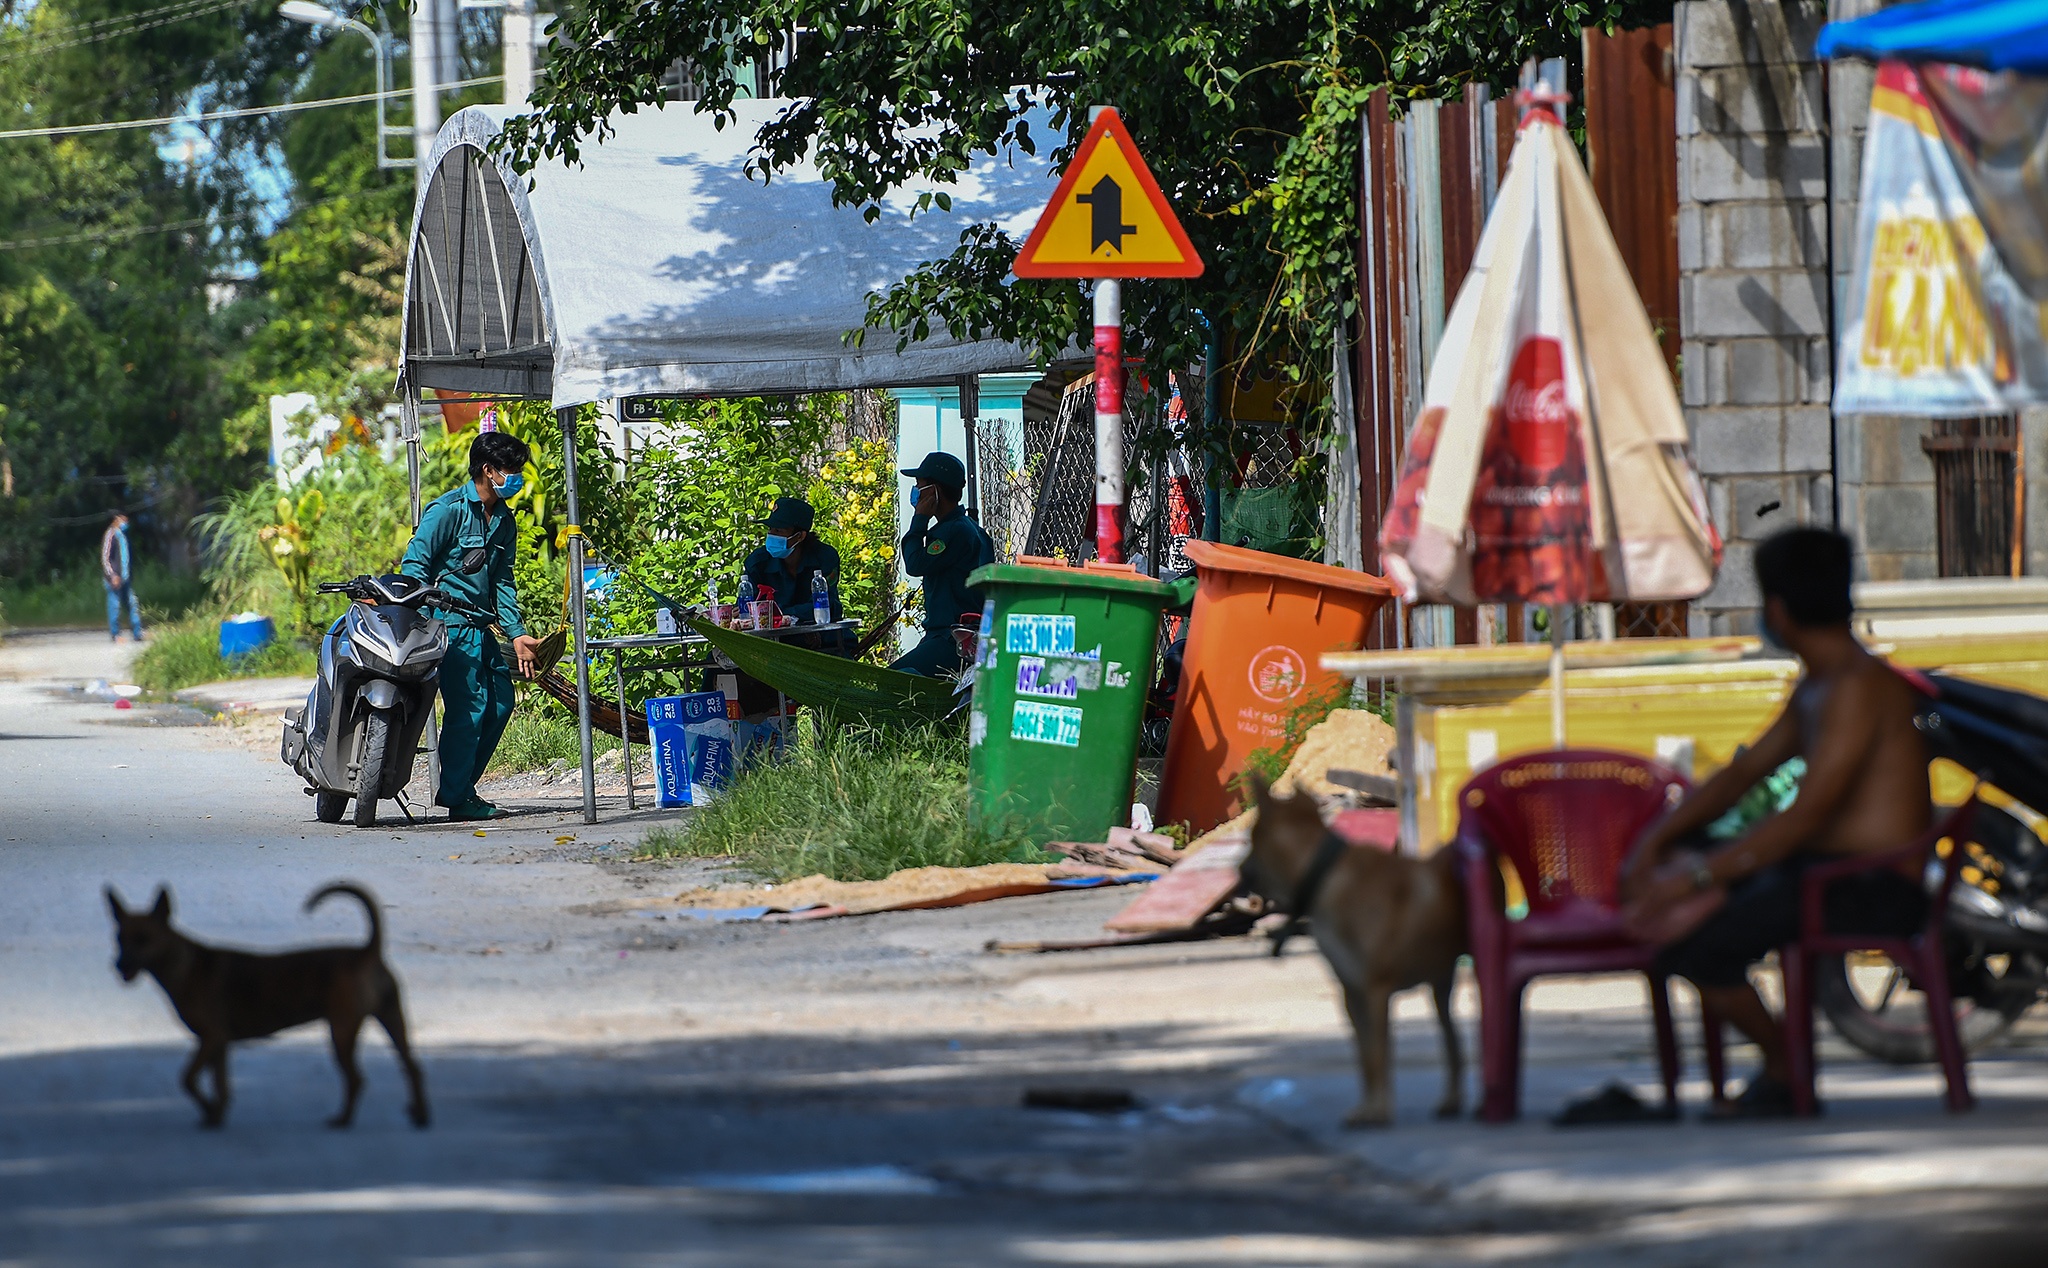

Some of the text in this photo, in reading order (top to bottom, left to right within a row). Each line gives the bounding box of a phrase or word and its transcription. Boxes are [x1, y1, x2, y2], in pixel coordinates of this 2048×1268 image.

[633, 403, 645, 414] FB
[664, 703, 672, 719] 28
[706, 697, 717, 713] 28
[662, 738, 678, 798] AQUAFINA
[700, 740, 722, 788] AQUAFINA
